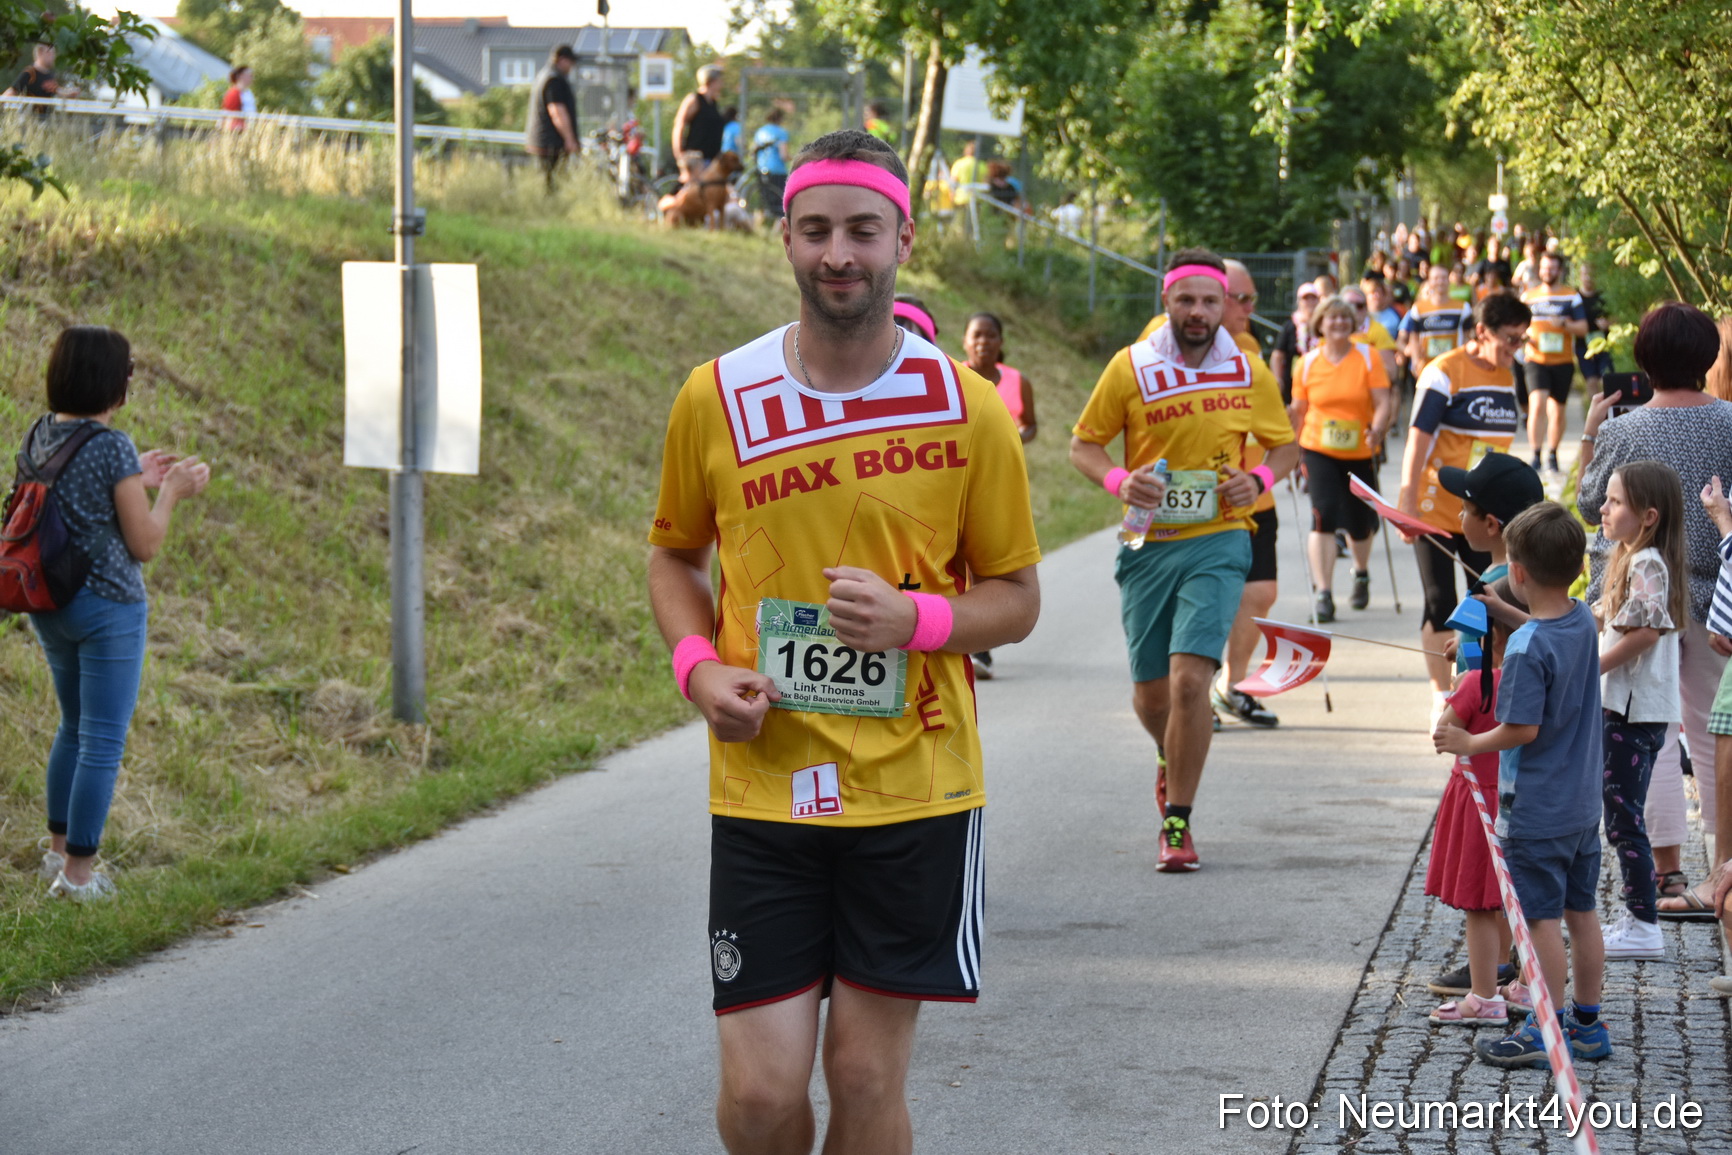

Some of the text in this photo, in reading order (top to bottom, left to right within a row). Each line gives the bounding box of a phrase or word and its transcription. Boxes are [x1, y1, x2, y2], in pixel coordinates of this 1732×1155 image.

[1145, 393, 1252, 427] MAX BÖGL
[742, 438, 967, 510] MAX BÖGL
[1158, 489, 1207, 509] 637
[778, 640, 887, 687] 1626
[794, 681, 865, 697] Link Thomas
[794, 693, 811, 702] Bögl
[812, 695, 854, 705] Bauservice
